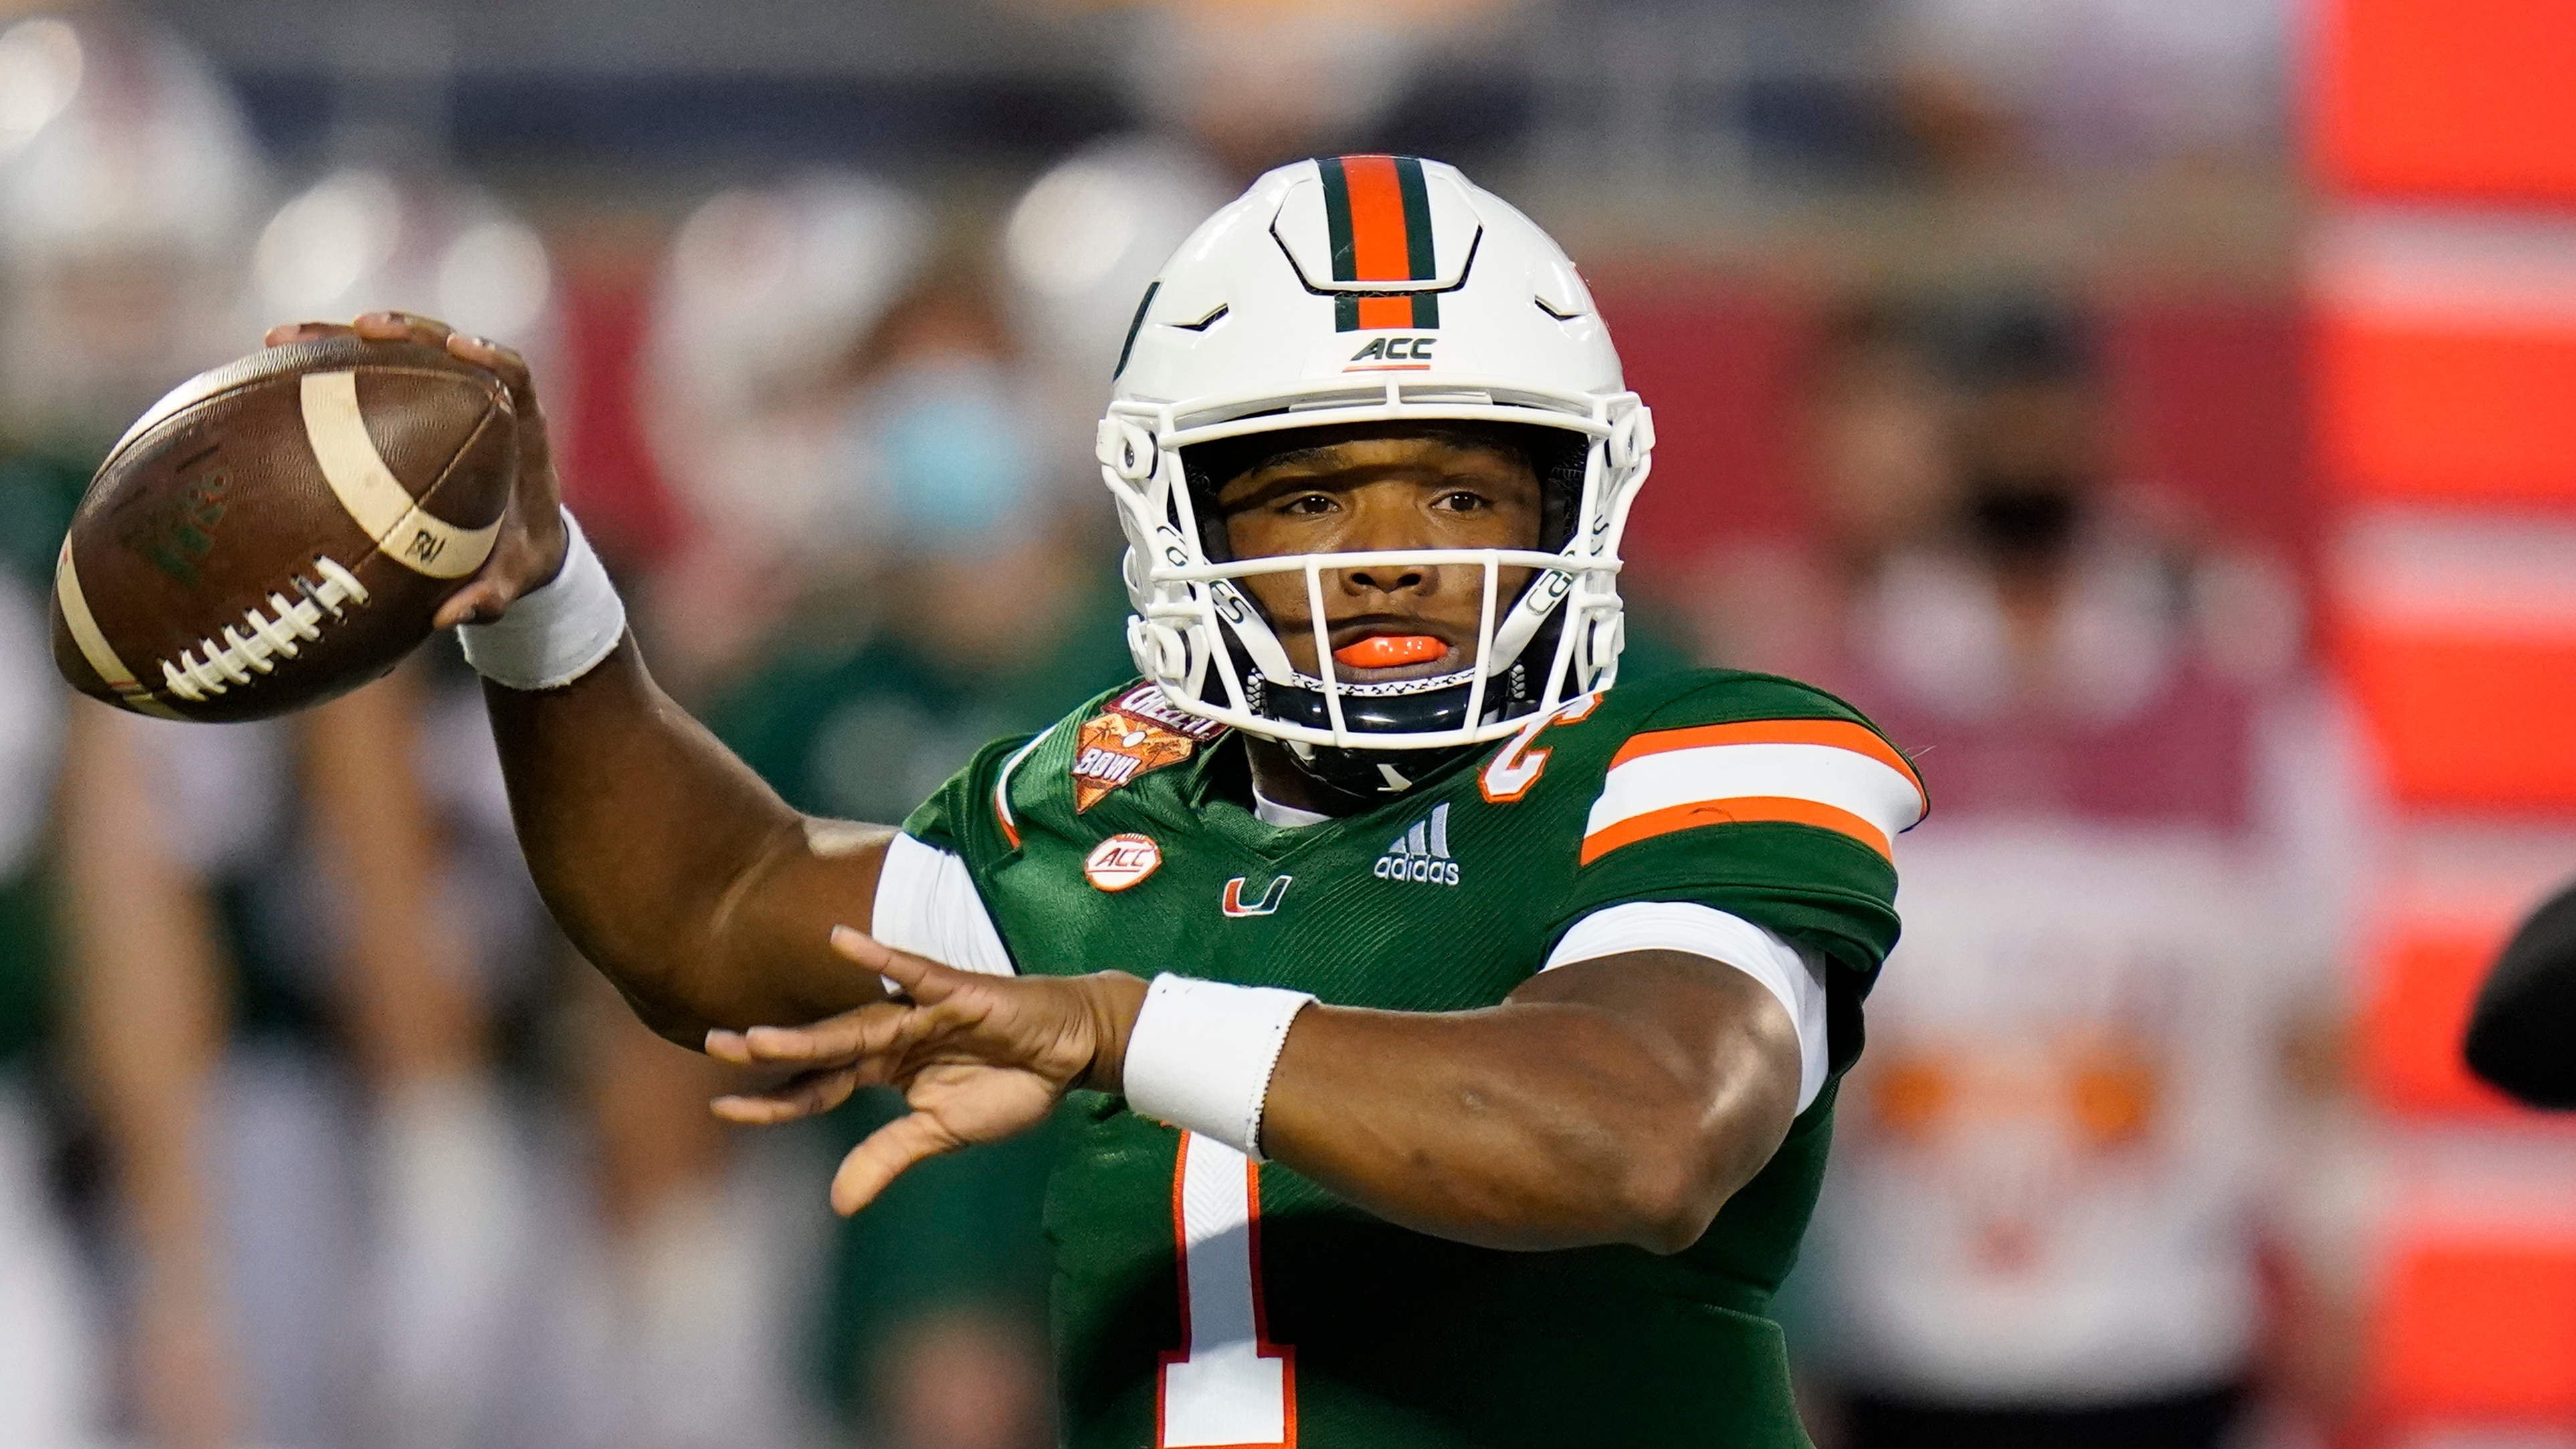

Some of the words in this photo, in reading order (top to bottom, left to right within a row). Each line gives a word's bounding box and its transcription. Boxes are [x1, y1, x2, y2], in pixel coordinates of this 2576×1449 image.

[1350, 337, 1438, 361] ACC
[1074, 747, 1141, 783] BOWL
[1477, 693, 1605, 803] C
[1095, 847, 1153, 867] ACC
[1373, 852, 1460, 886] adidas
[1222, 874, 1293, 918] U
[1157, 1121, 1297, 1449] 1
